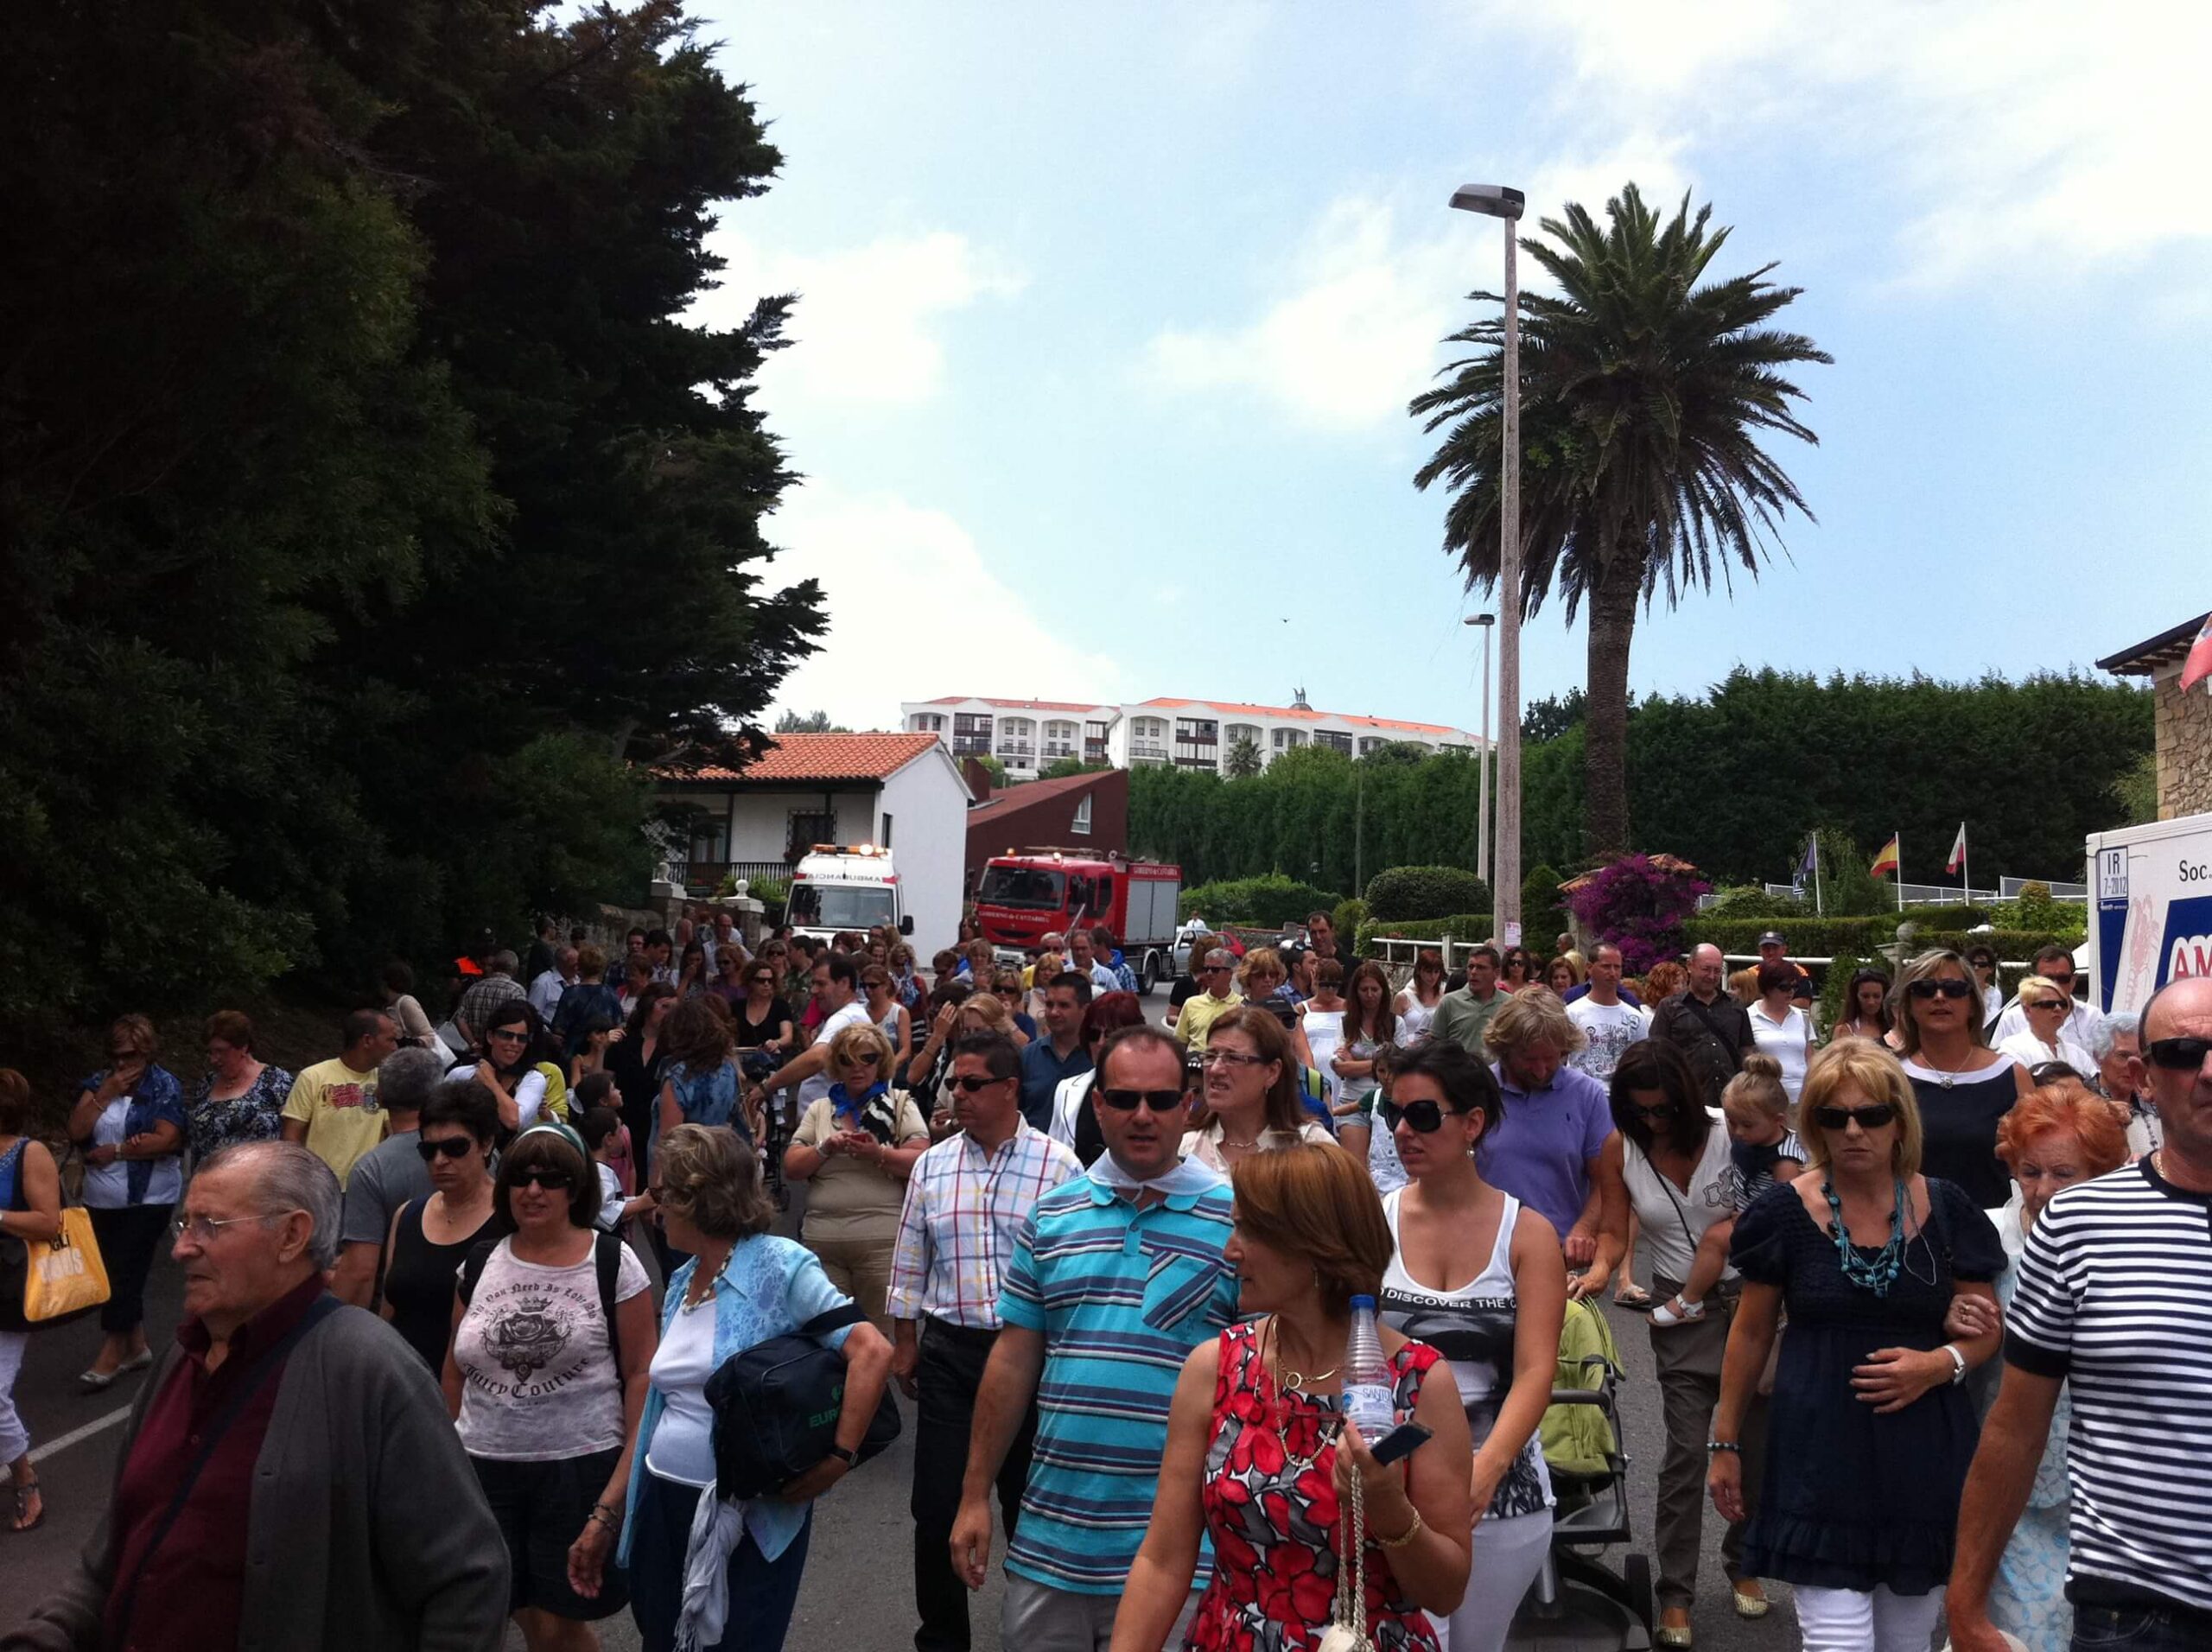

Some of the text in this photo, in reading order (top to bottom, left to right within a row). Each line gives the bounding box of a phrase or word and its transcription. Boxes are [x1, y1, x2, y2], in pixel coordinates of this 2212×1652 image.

[2107, 853, 2120, 874] IR
[511, 1283, 540, 1294] Need
[1387, 1289, 1471, 1309] DISCOVER
[1475, 1299, 1506, 1309] THE
[463, 1357, 590, 1400] Juicy Couture
